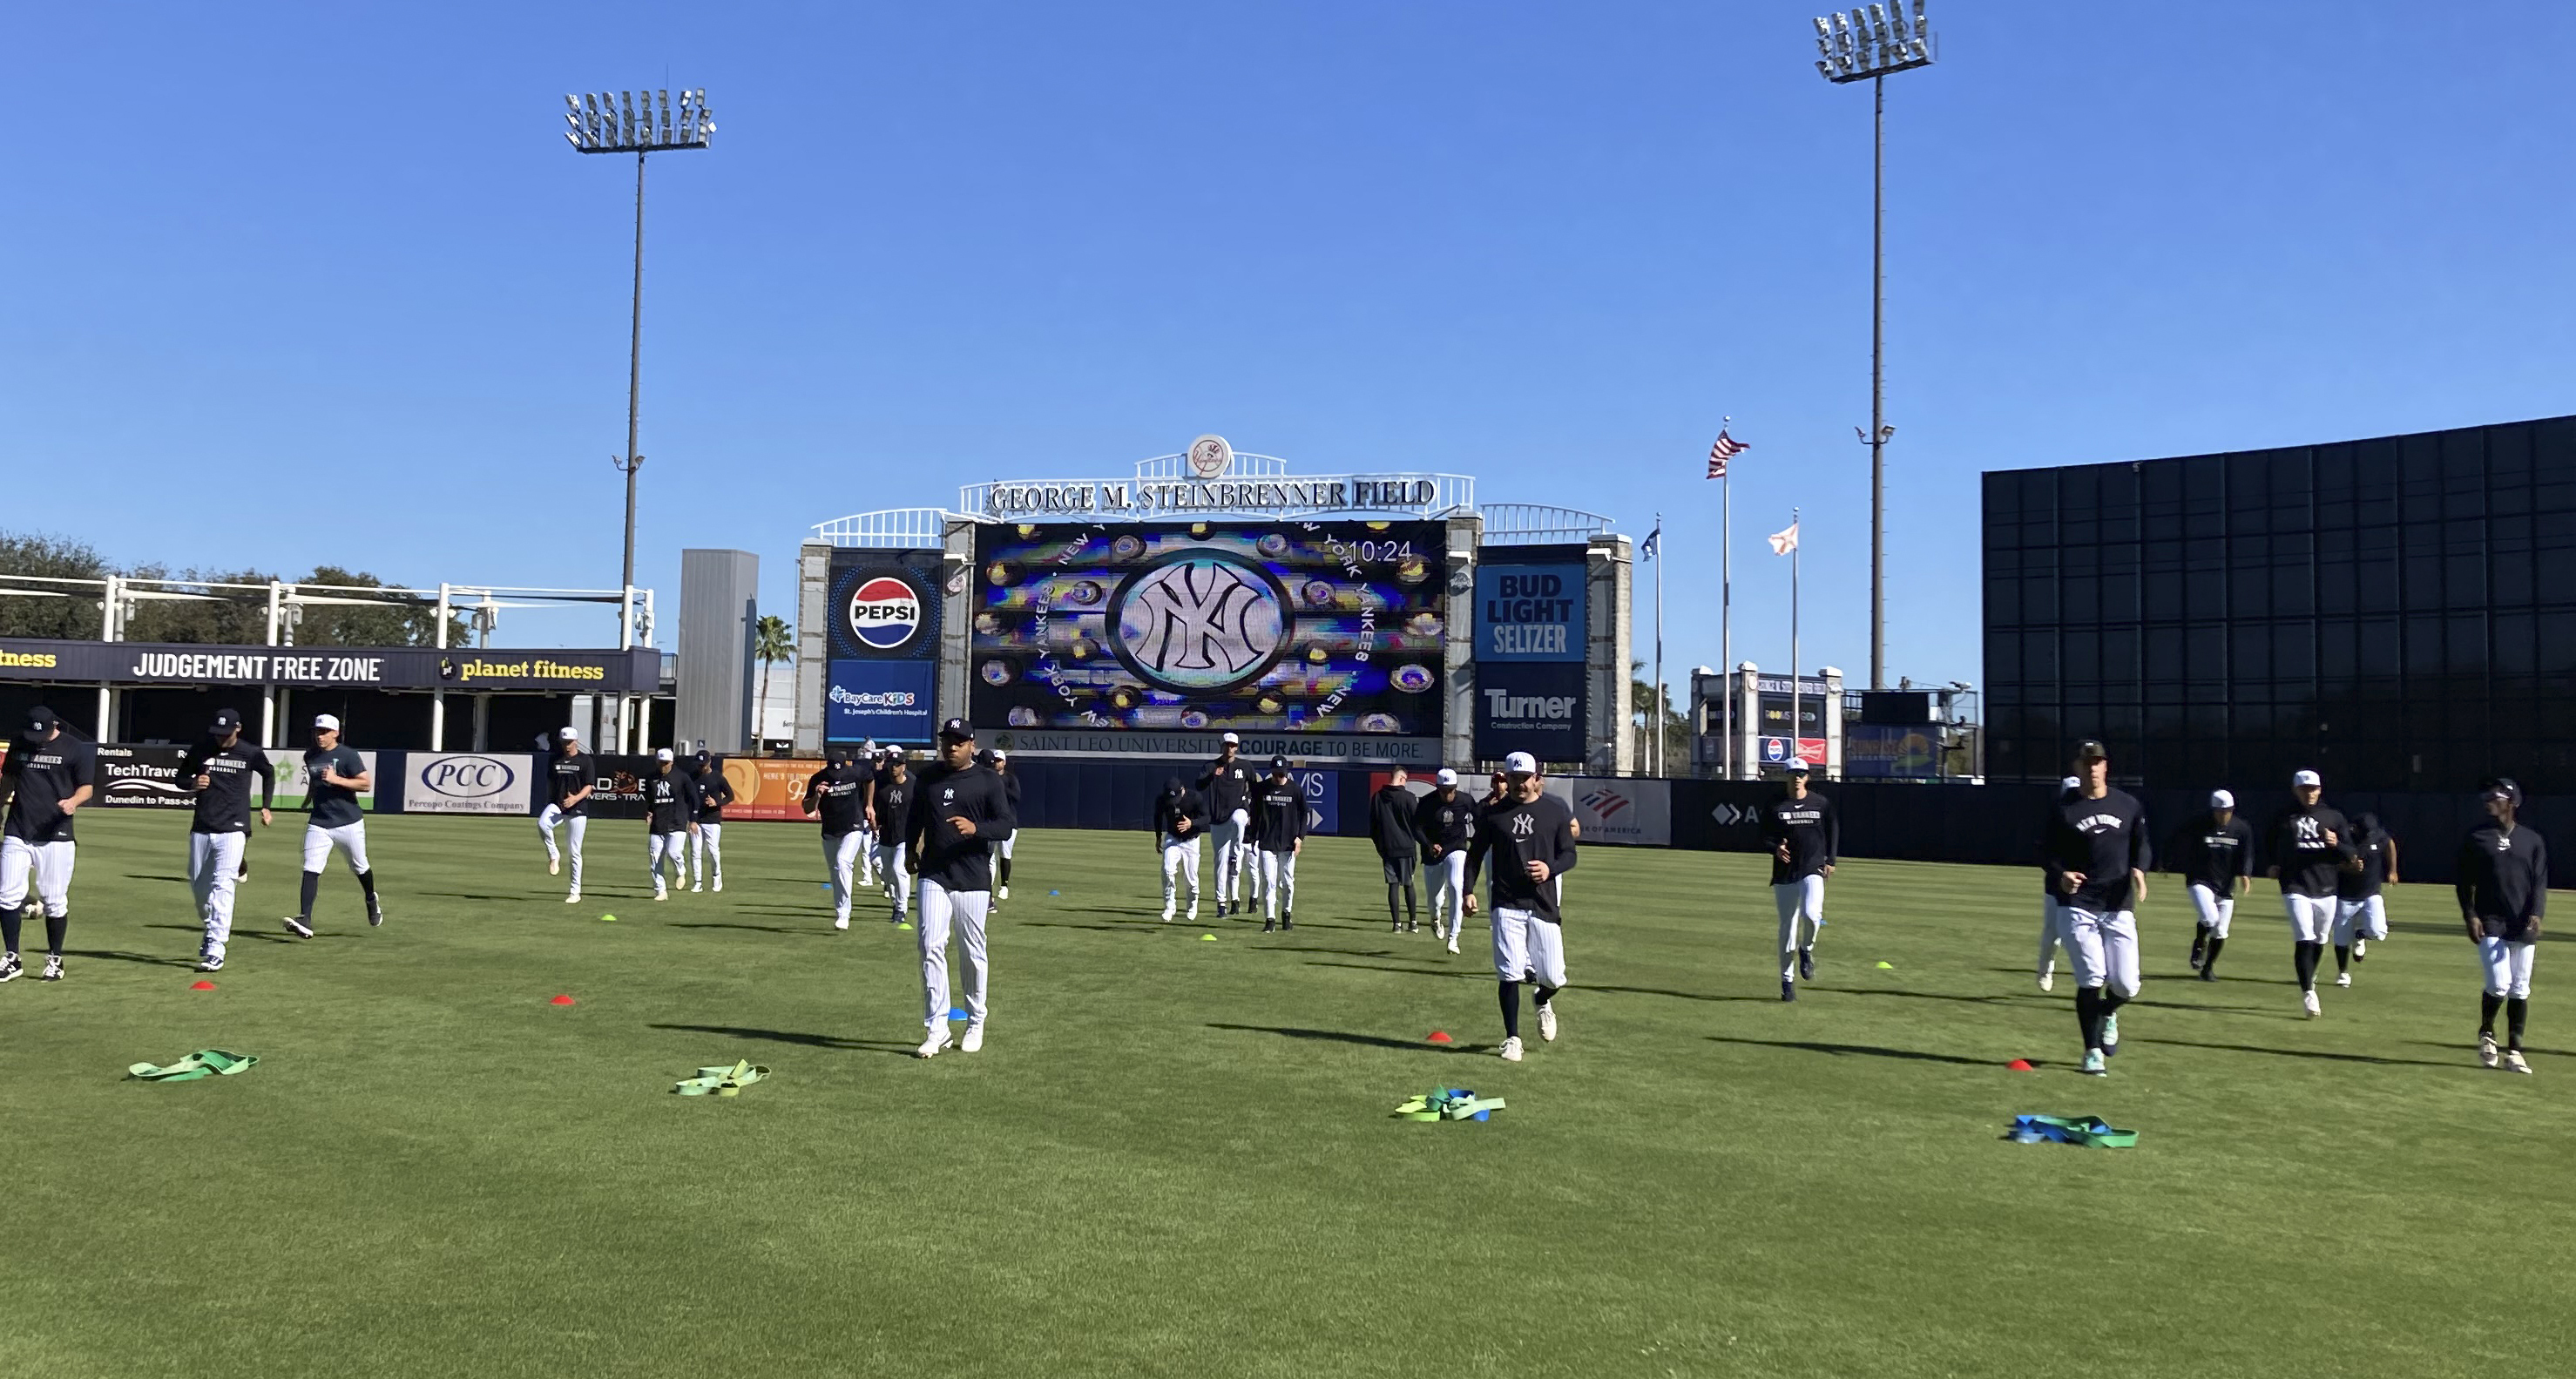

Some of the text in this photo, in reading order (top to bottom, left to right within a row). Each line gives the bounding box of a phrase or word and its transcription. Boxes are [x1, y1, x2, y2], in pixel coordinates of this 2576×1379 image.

[991, 480, 1436, 511] GEORGE M. STEINBRENNER FIELD
[1349, 540, 1411, 562] 10:24
[1499, 574, 1562, 598] BUD
[855, 605, 915, 620] PEPSI
[1487, 599, 1573, 623] LIGHT
[1493, 625, 1566, 653] SELTZER
[133, 653, 268, 679] JUDGEMENT
[272, 657, 323, 680] FREE
[460, 659, 605, 681] planet fitness
[844, 693, 883, 706] BayCare
[1484, 688, 1577, 720] Turner
[1491, 721, 1572, 731] Construction Company
[97, 747, 132, 757] Rentals
[1019, 736, 1070, 751] SAINT
[1077, 737, 1112, 752] LEO
[1239, 740, 1424, 759] COURAGE TO BE MORE.
[436, 764, 497, 788] PCC
[105, 794, 144, 806] Dunedin
[147, 796, 157, 806] to
[409, 799, 525, 812] Percopo Coatings Company
[1511, 813, 1535, 835] NY
[1604, 826, 1642, 835] AMERICA
